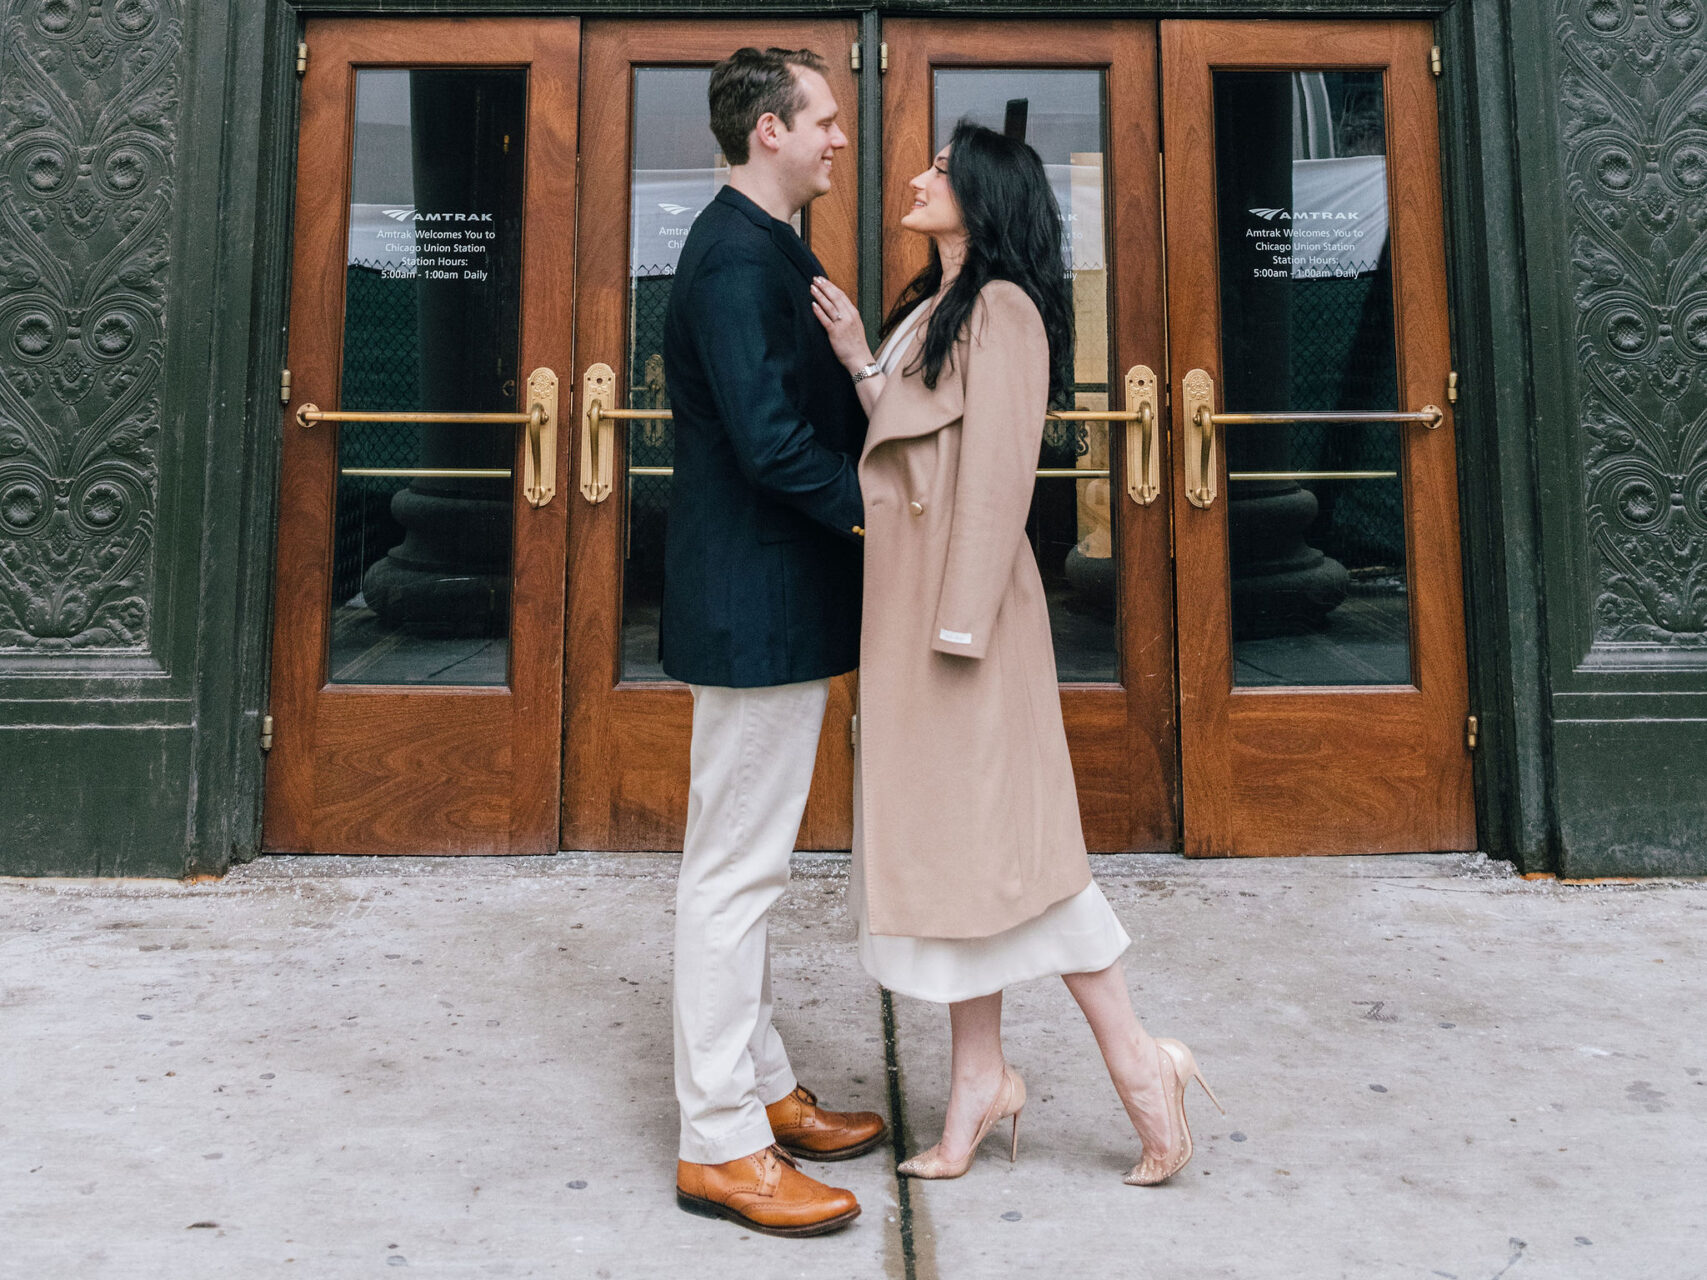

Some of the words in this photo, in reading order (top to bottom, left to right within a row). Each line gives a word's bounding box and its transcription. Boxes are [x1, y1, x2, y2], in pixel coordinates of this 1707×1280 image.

[412, 213, 493, 221] AMTRAK
[1279, 211, 1359, 220] AMTRAK
[376, 229, 412, 239] Amtrak
[414, 229, 462, 239] Welcomes
[464, 230, 483, 239] You
[485, 231, 496, 239] to
[659, 226, 692, 236] Amtra
[1245, 228, 1281, 238] Amtrak
[1283, 228, 1331, 238] Welcomes
[1333, 228, 1351, 237] You
[1353, 229, 1364, 238] to
[385, 243, 421, 254] Chicago
[423, 244, 451, 252] Union
[453, 243, 486, 253] Station
[1255, 242, 1292, 253] Chicago
[1293, 242, 1321, 251] Union
[1323, 242, 1356, 251] Station
[401, 256, 435, 266] Station
[438, 257, 468, 266] Hours:
[1272, 255, 1306, 265] Station
[1309, 255, 1339, 265] Hours:
[381, 270, 416, 279] 5:00am
[424, 270, 458, 279] 1:00am
[463, 270, 488, 281] Daily
[1253, 268, 1288, 278] 5:00am
[1297, 268, 1331, 278] 1:00am
[1335, 268, 1360, 280] Daily
